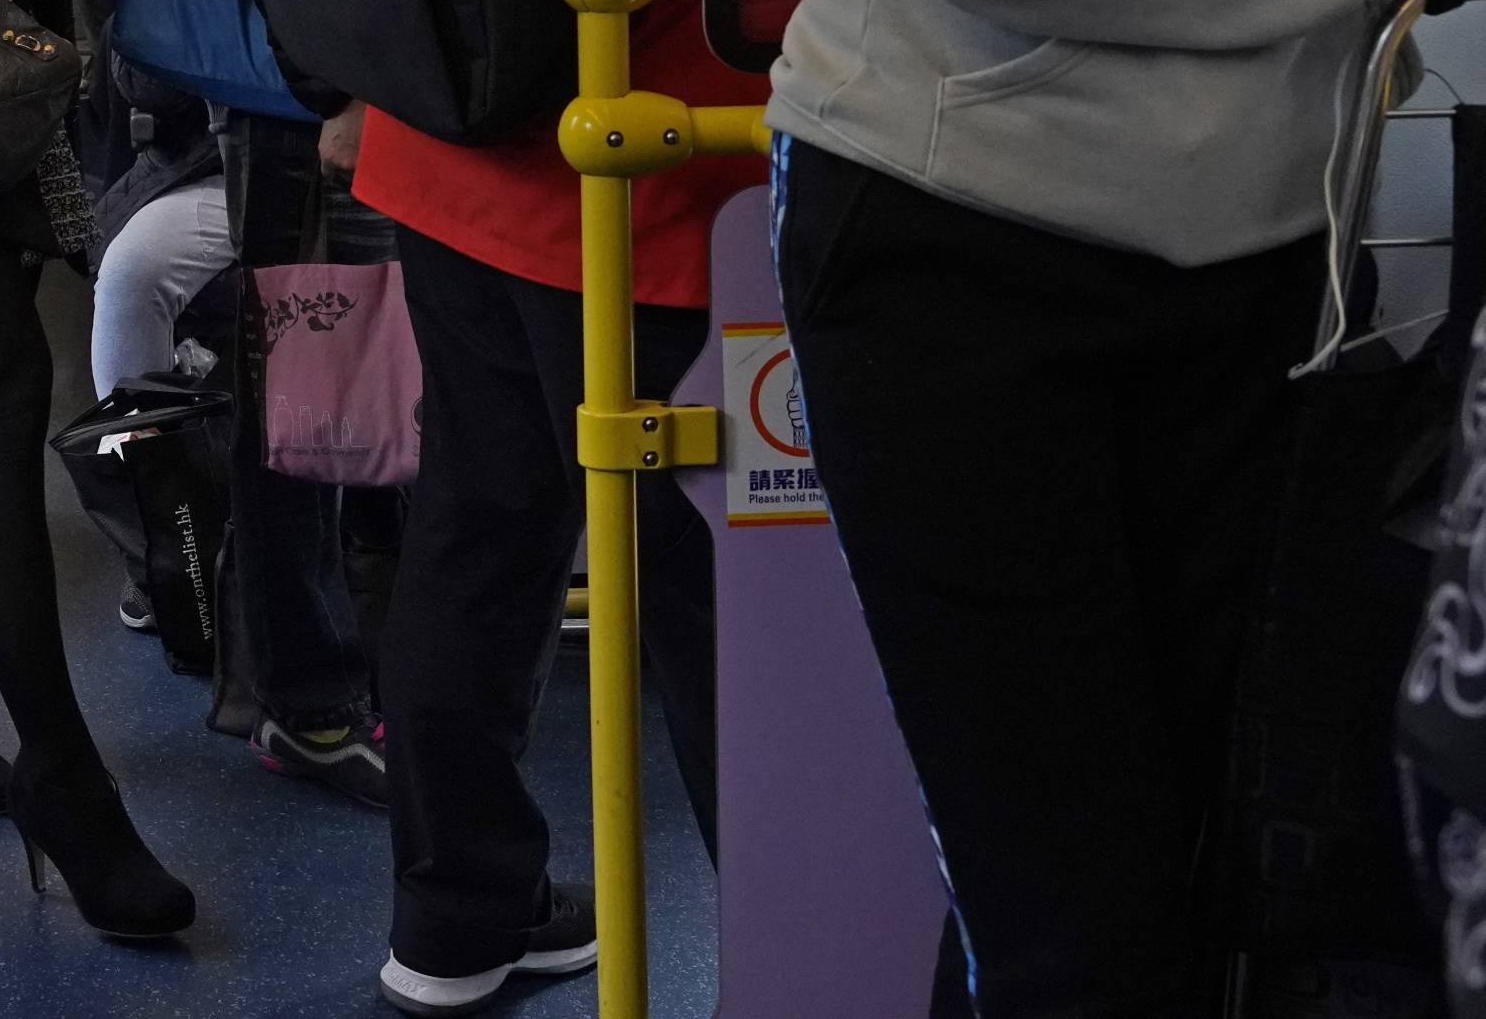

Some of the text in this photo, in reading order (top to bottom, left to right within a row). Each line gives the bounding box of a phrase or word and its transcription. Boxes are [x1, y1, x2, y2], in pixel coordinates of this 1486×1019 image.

[749, 491, 824, 504] Please hold the
[175, 503, 213, 640] www.onthelist.hk
